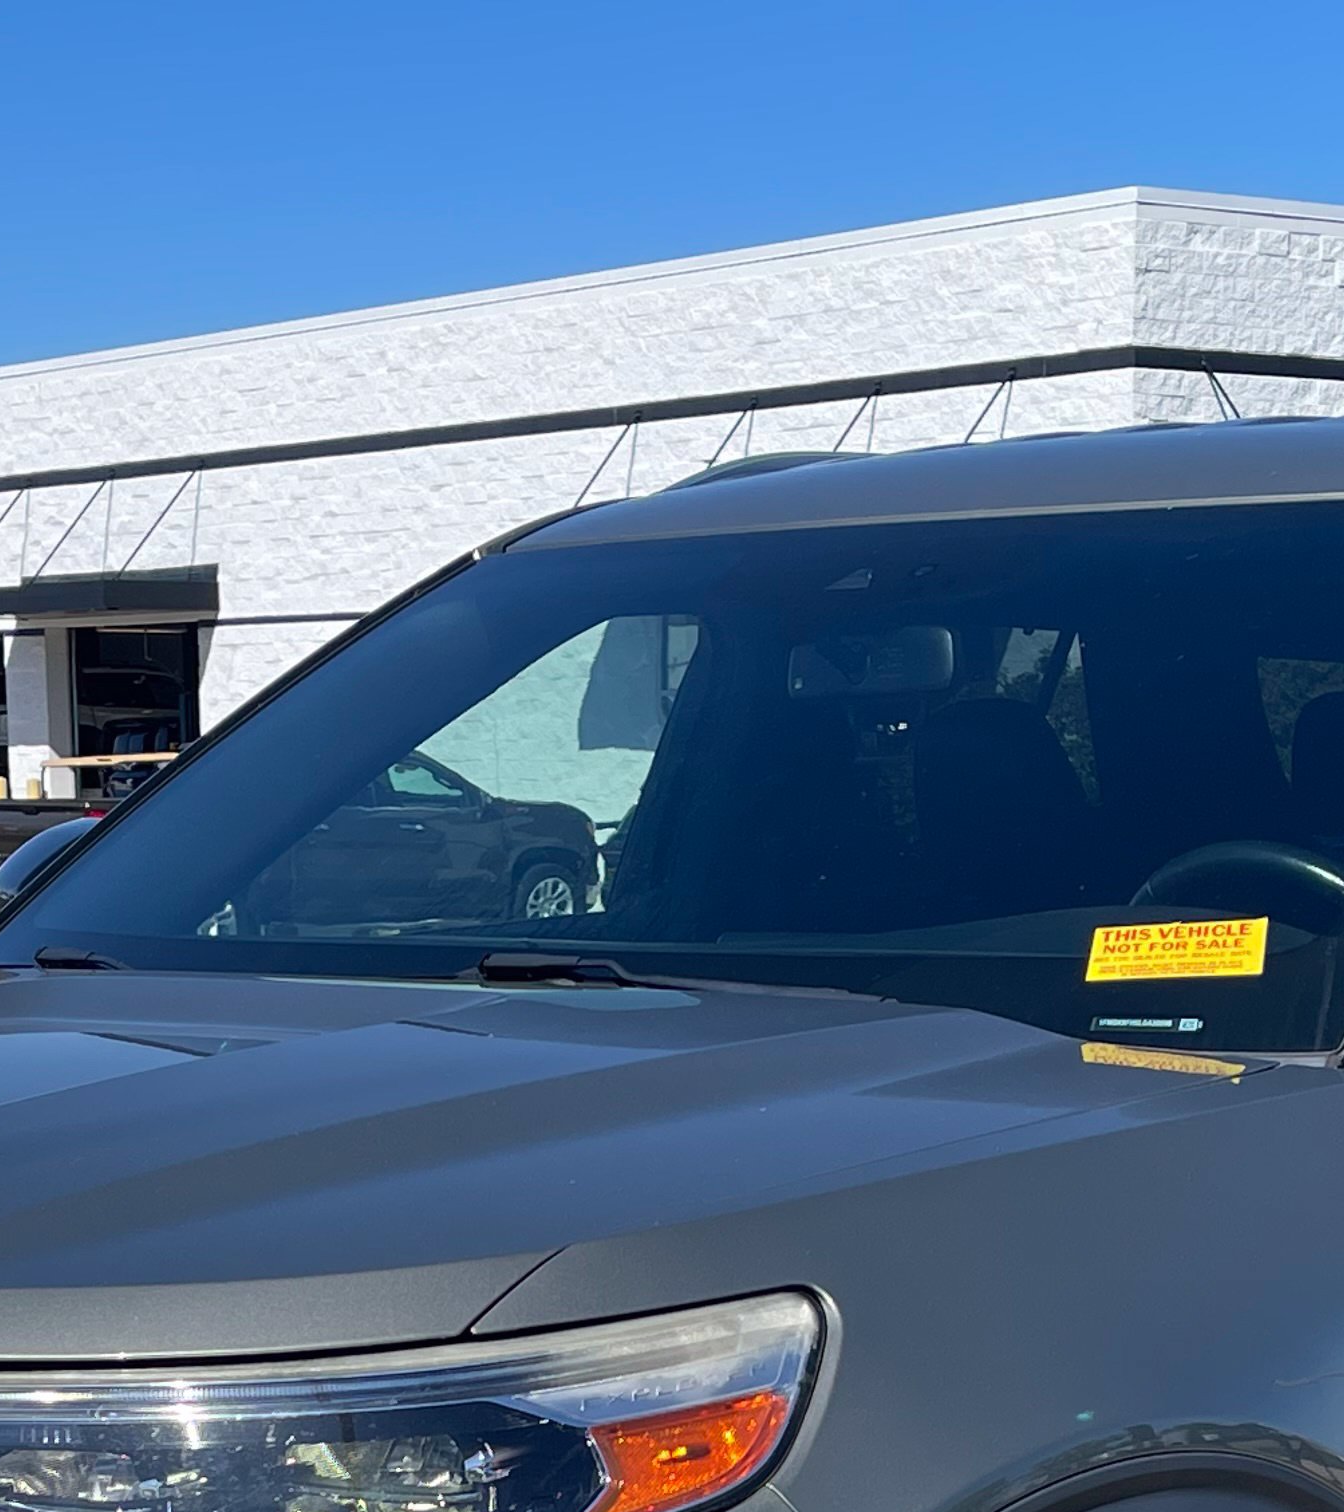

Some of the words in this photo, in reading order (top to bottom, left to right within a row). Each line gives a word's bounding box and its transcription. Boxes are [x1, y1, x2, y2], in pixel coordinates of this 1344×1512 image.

[1102, 928, 1152, 943] THIS
[1158, 922, 1253, 940] VEHICLE
[1103, 942, 1145, 955] NOT
[1149, 940, 1188, 953] FOR
[1196, 937, 1245, 950] SALE
